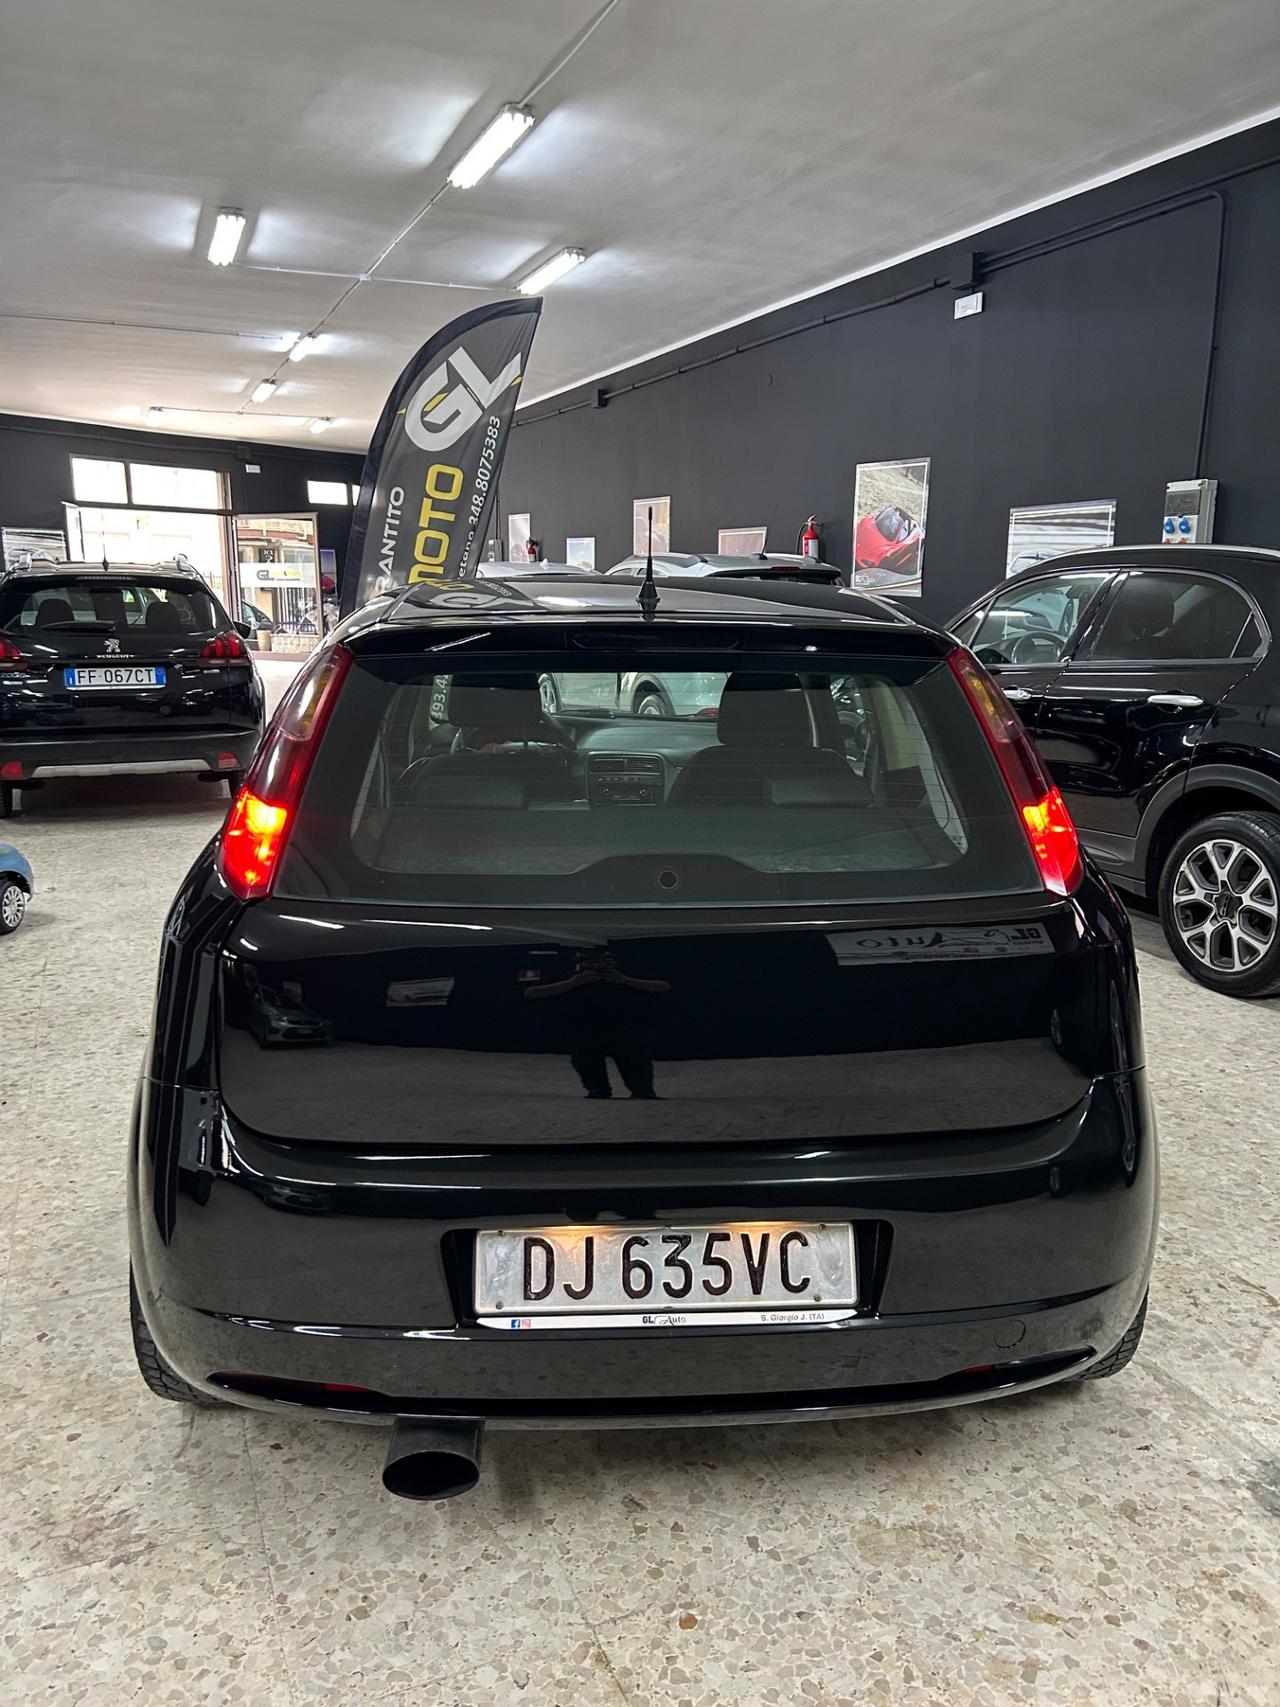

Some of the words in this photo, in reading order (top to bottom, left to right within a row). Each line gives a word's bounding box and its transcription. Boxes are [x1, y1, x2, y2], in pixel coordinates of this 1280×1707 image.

[458, 531, 475, 579] etano
[469, 415, 501, 527] 348.8075383
[77, 669, 97, 684] FF
[103, 668, 154, 683] 067CT
[431, 675, 449, 720] 393.4
[523, 1235, 594, 1301] DJ
[621, 1231, 810, 1300] 635VC
[760, 1314, 769, 1322] S.
[809, 1312, 825, 1321] (TA)
